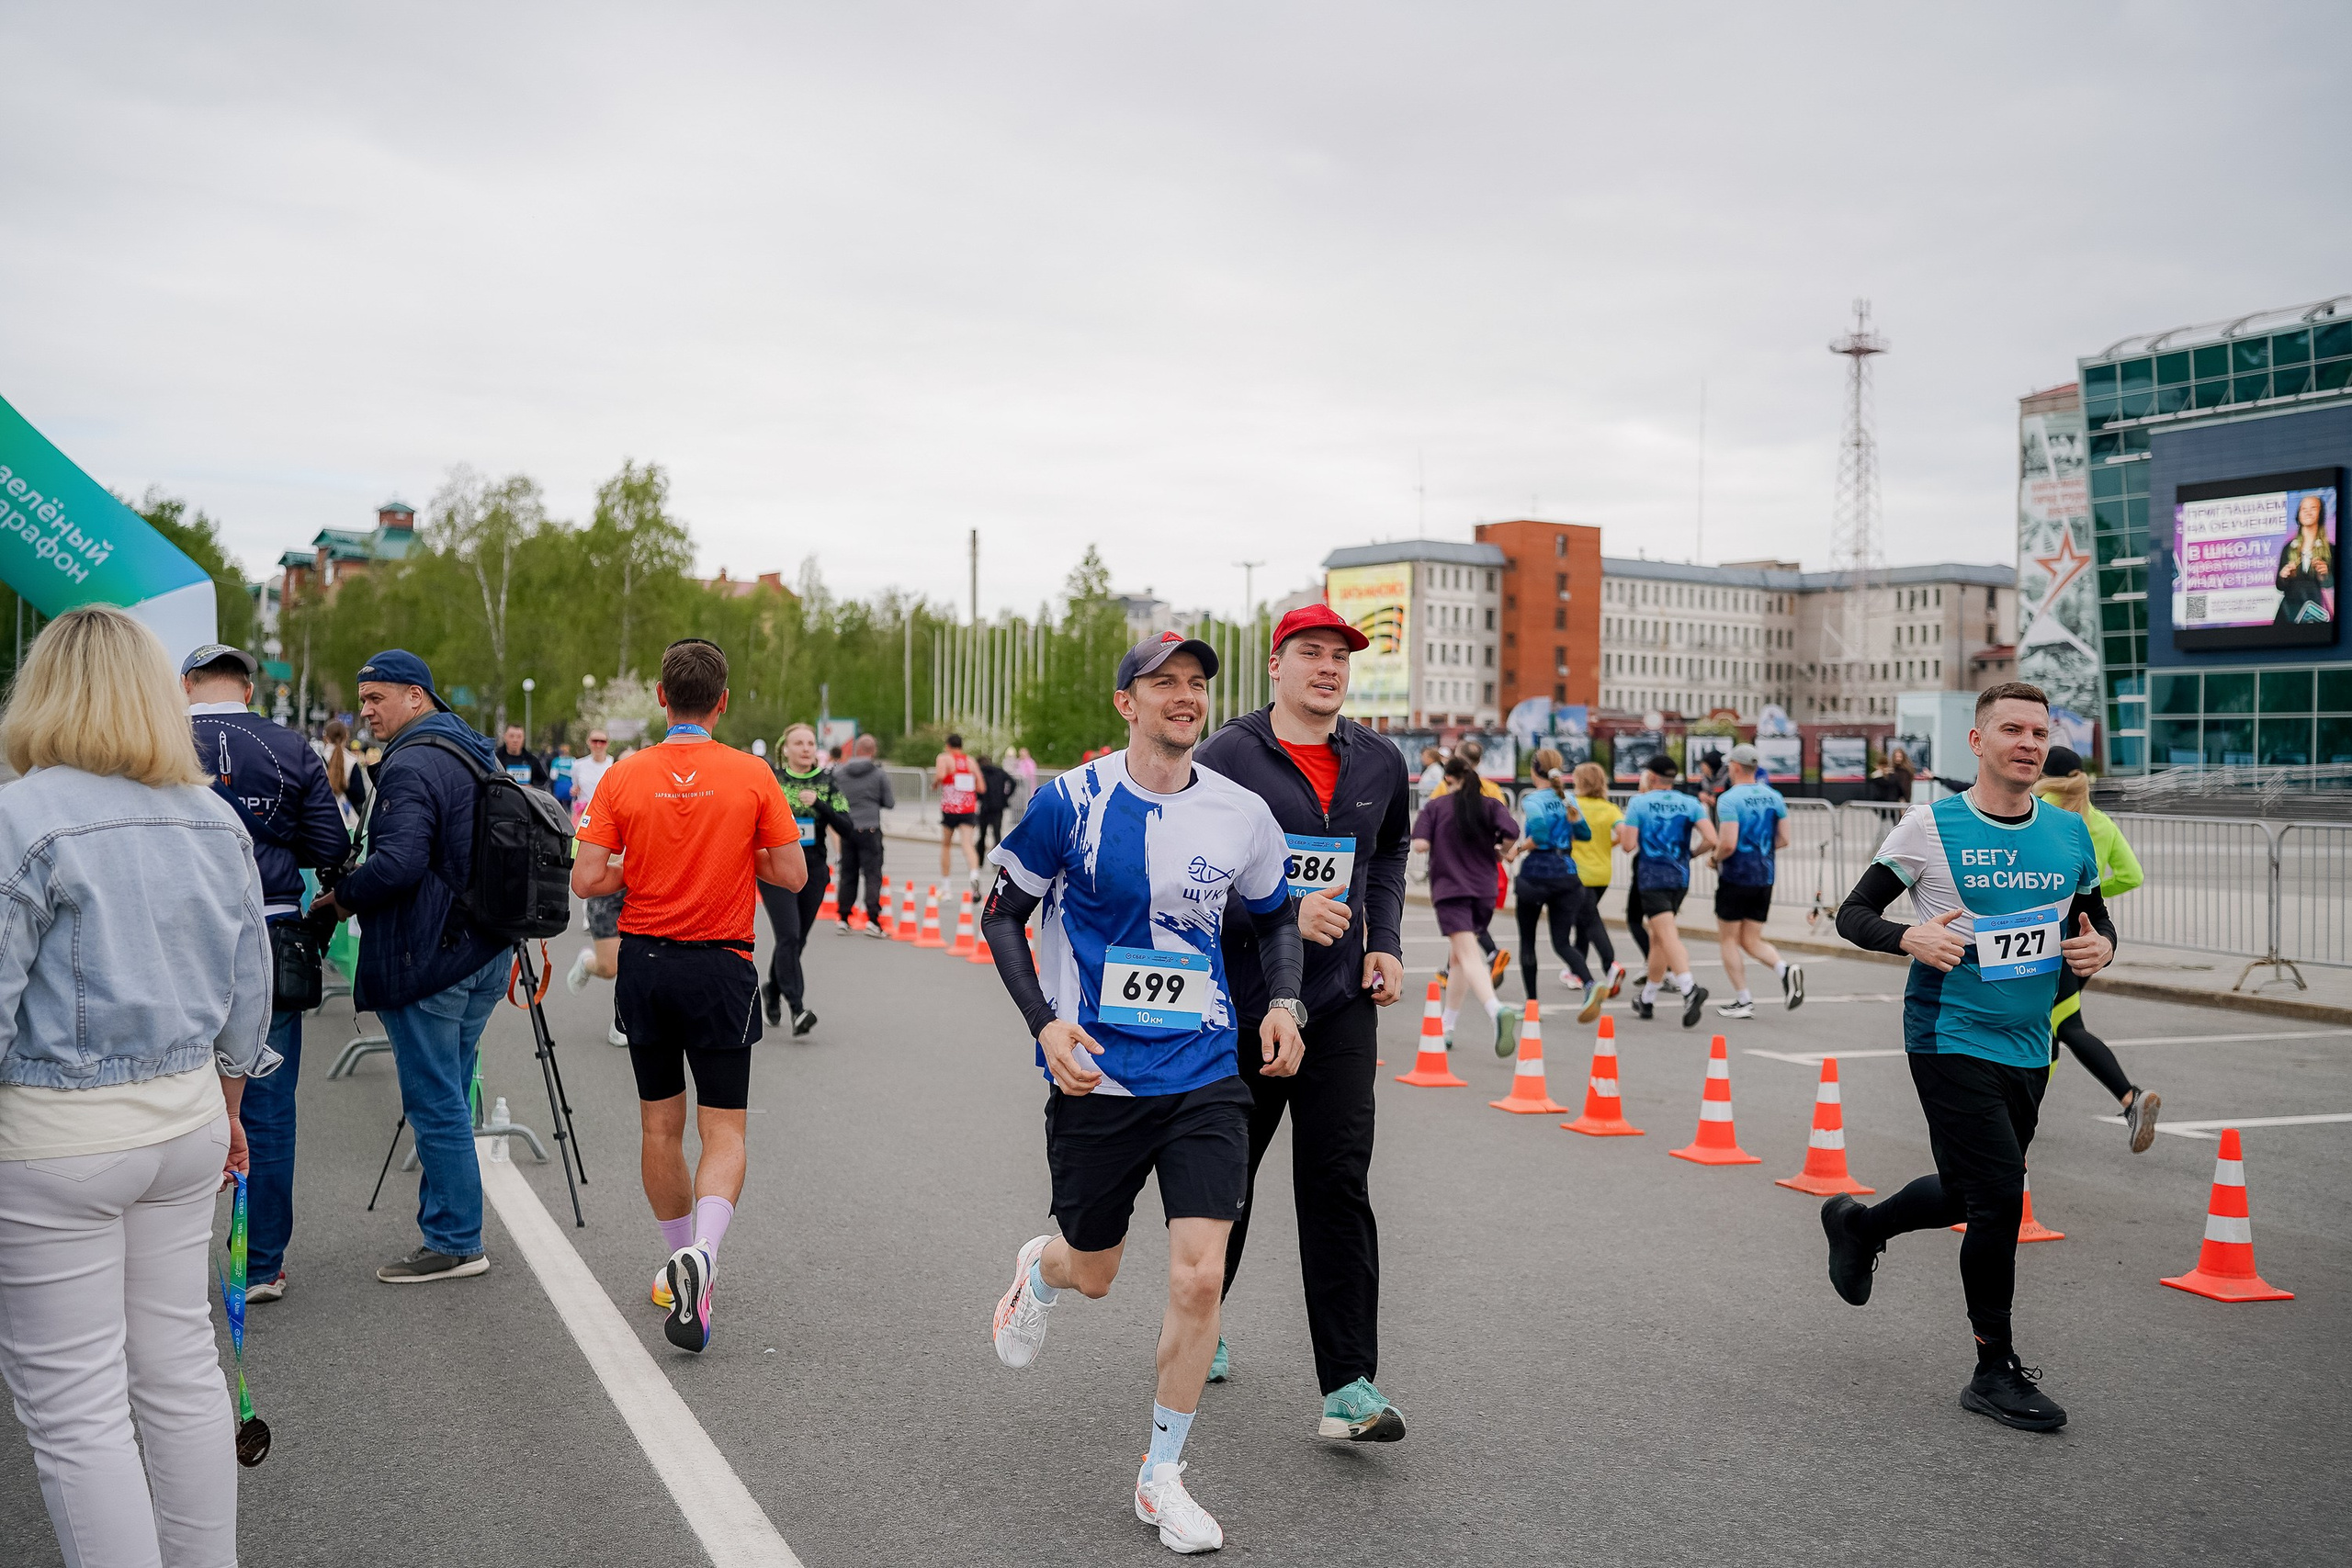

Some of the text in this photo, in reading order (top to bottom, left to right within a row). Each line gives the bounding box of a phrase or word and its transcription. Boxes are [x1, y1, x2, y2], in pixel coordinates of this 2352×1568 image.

[2188, 539, 2273, 560] В ШКОЛУ
[1284, 854, 1336, 882] 586
[1962, 849, 2018, 866] БЕГУ
[1994, 930, 2046, 960] 727
[1123, 971, 1185, 1004] 699
